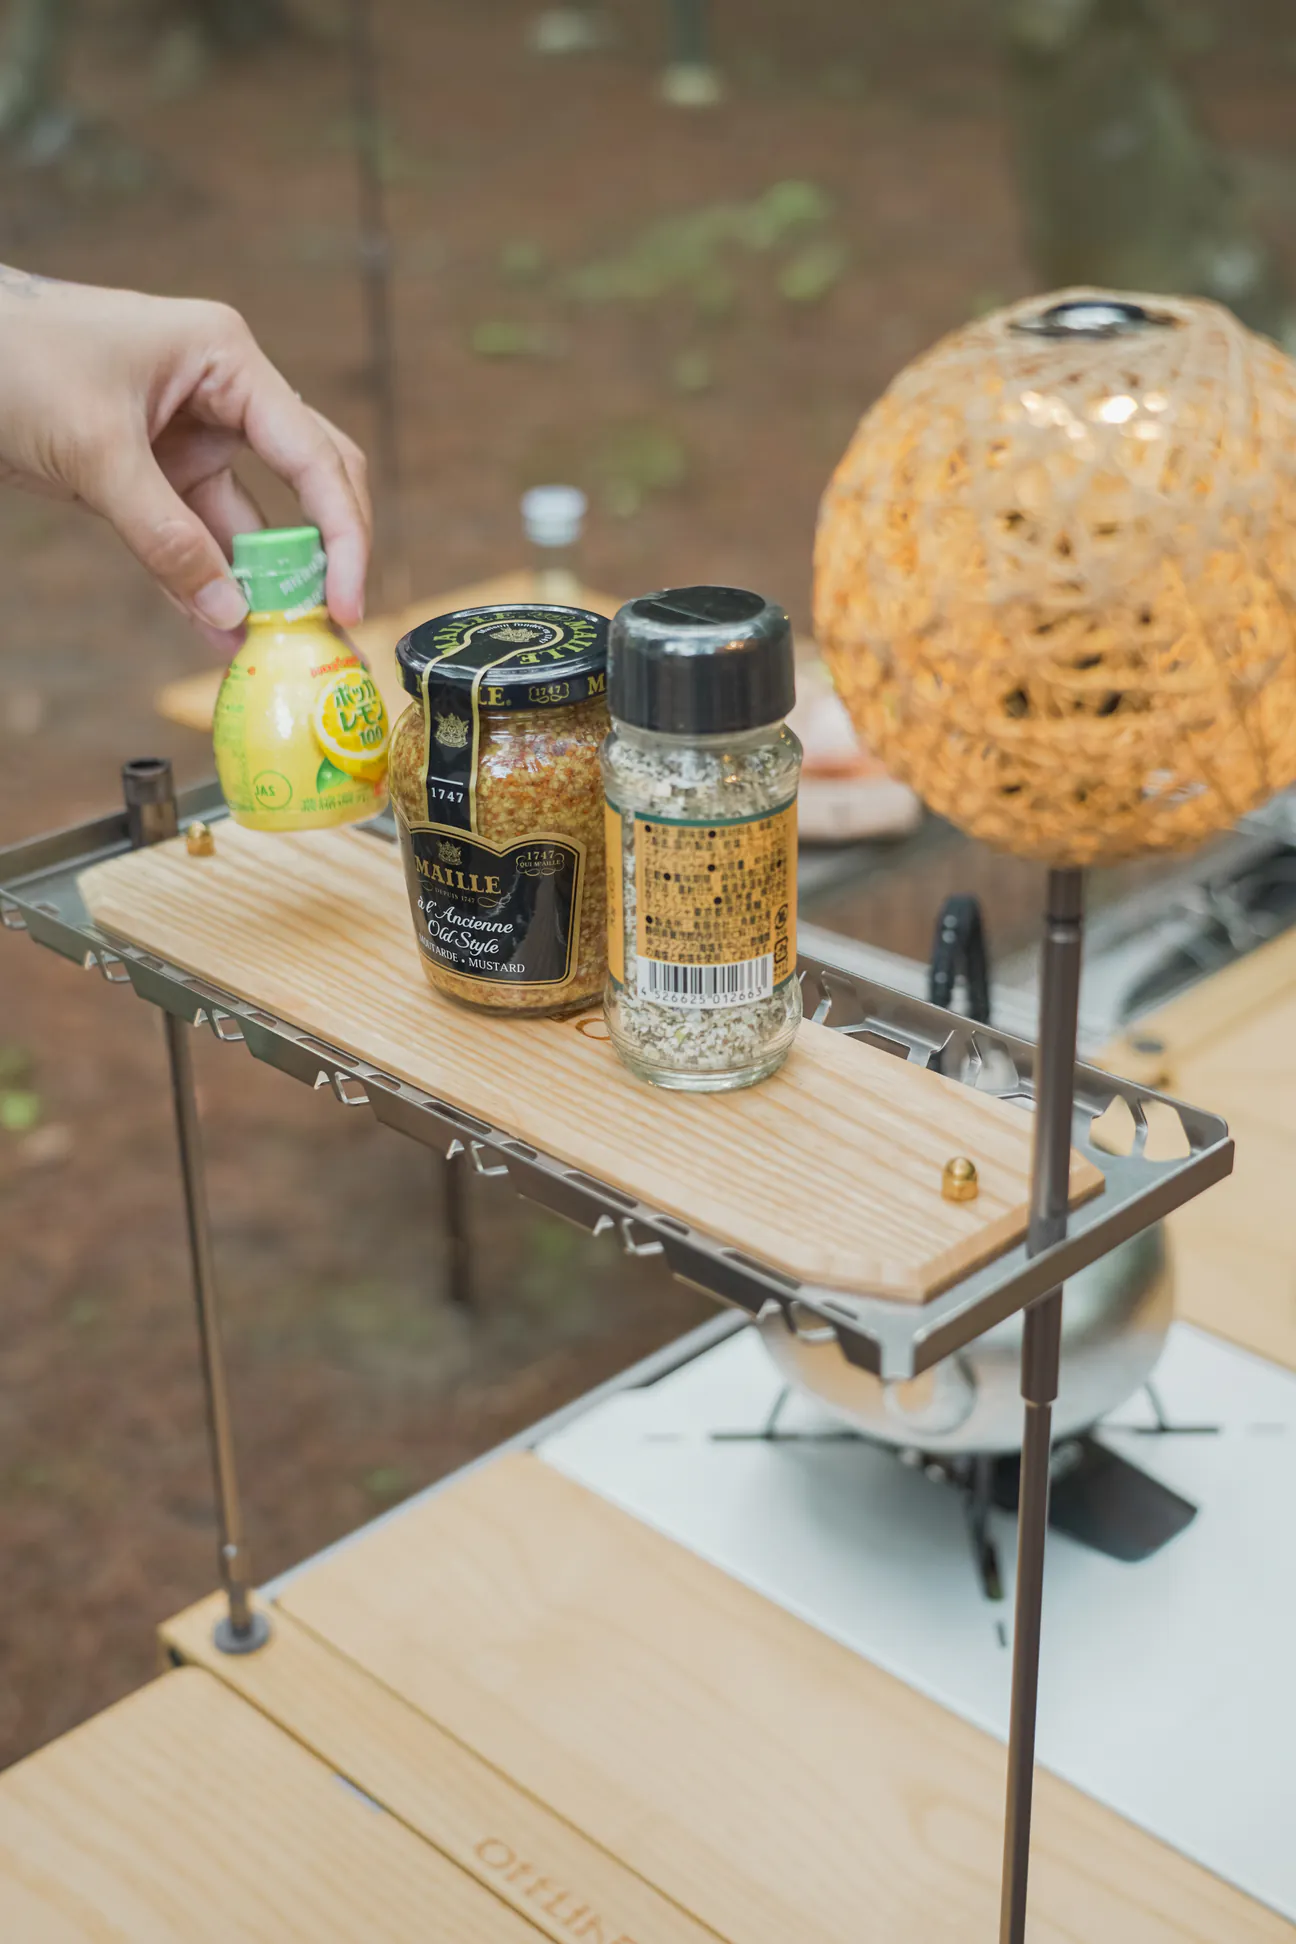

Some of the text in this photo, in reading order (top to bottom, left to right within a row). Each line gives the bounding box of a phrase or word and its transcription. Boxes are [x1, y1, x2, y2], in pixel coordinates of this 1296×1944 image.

[518, 620, 598, 664] MAILLE
[332, 678, 376, 709] ポッカ
[535, 684, 562, 697] 1747
[359, 725, 384, 747] 100
[430, 786, 464, 803] 1747
[527, 850, 555, 860] 1747
[519, 860, 534, 868] QUI
[415, 856, 502, 895] MAILLE
[461, 894, 475, 904] 1747
[427, 918, 500, 957] Old Style
[468, 957, 526, 974] MUSTARD
